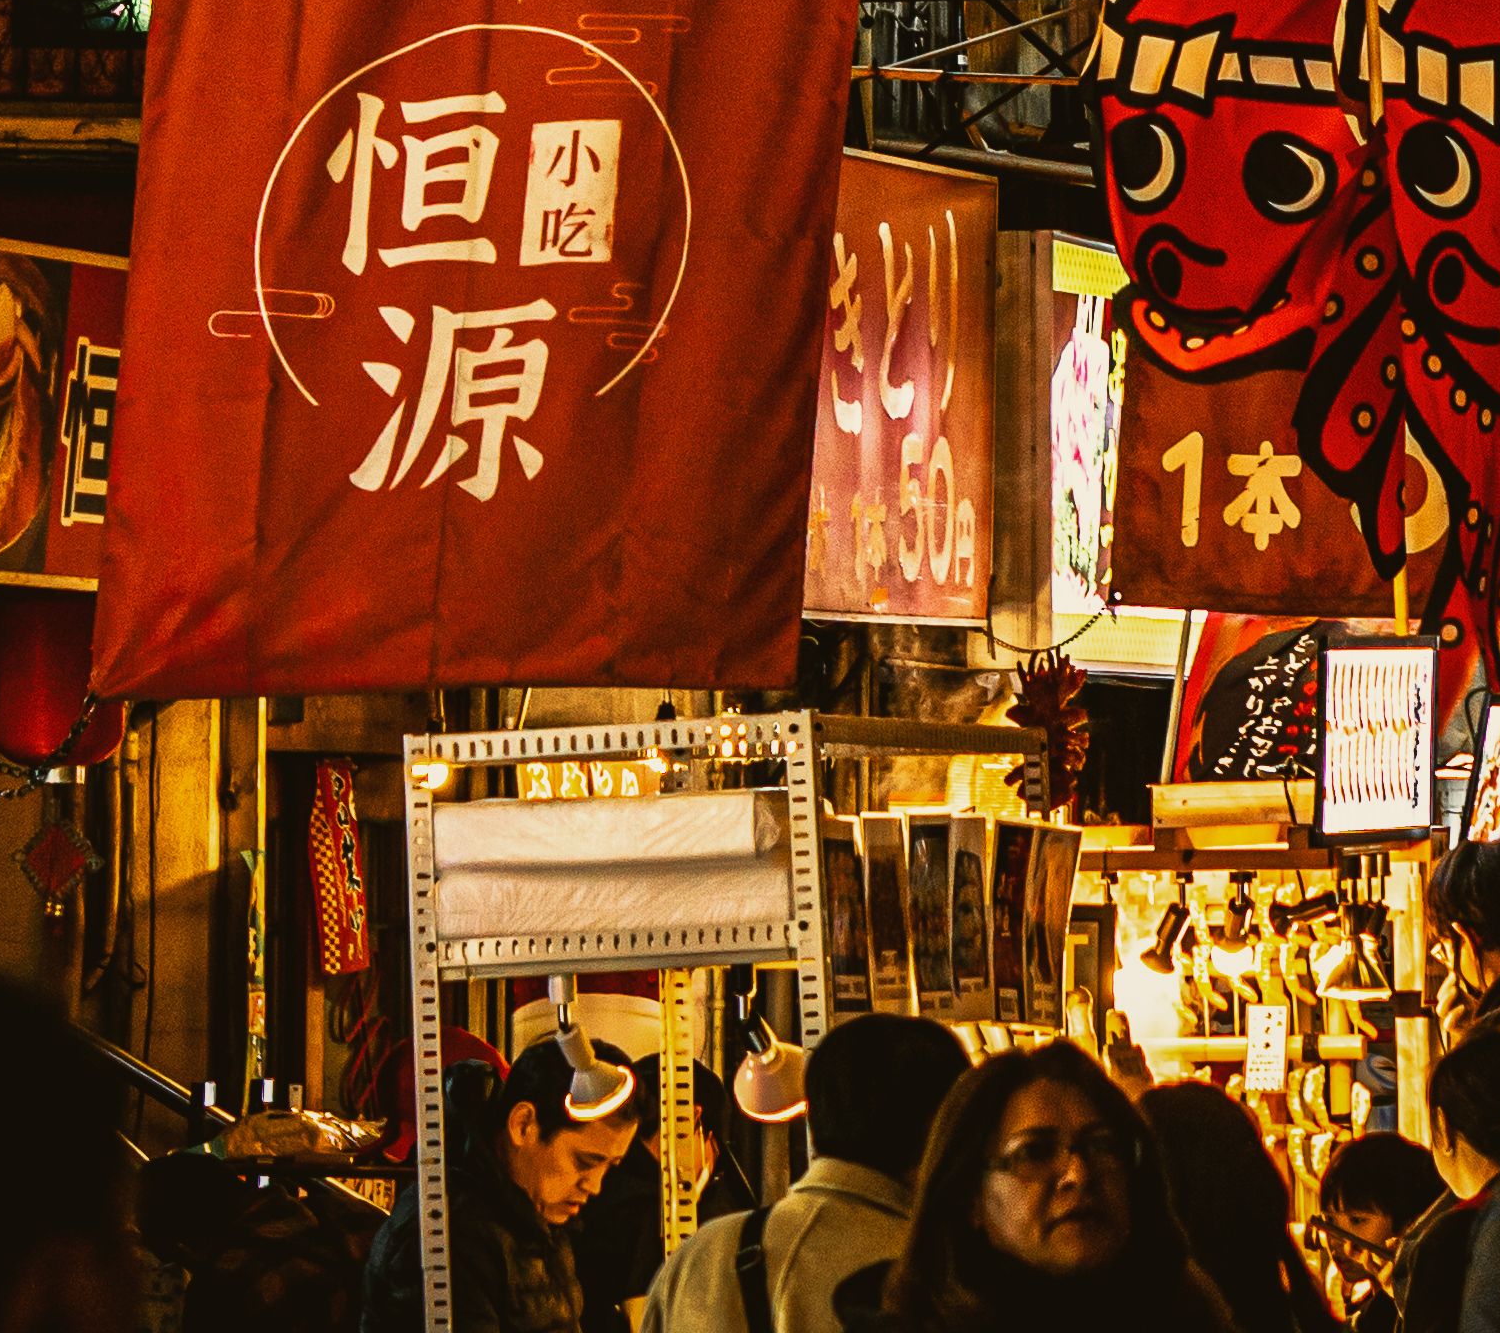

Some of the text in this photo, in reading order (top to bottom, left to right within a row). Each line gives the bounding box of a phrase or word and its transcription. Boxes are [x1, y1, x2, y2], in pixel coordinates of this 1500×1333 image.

[537, 131, 603, 261] 小吃
[325, 89, 560, 503] 恒源
[1161, 430, 1303, 551] 1本
